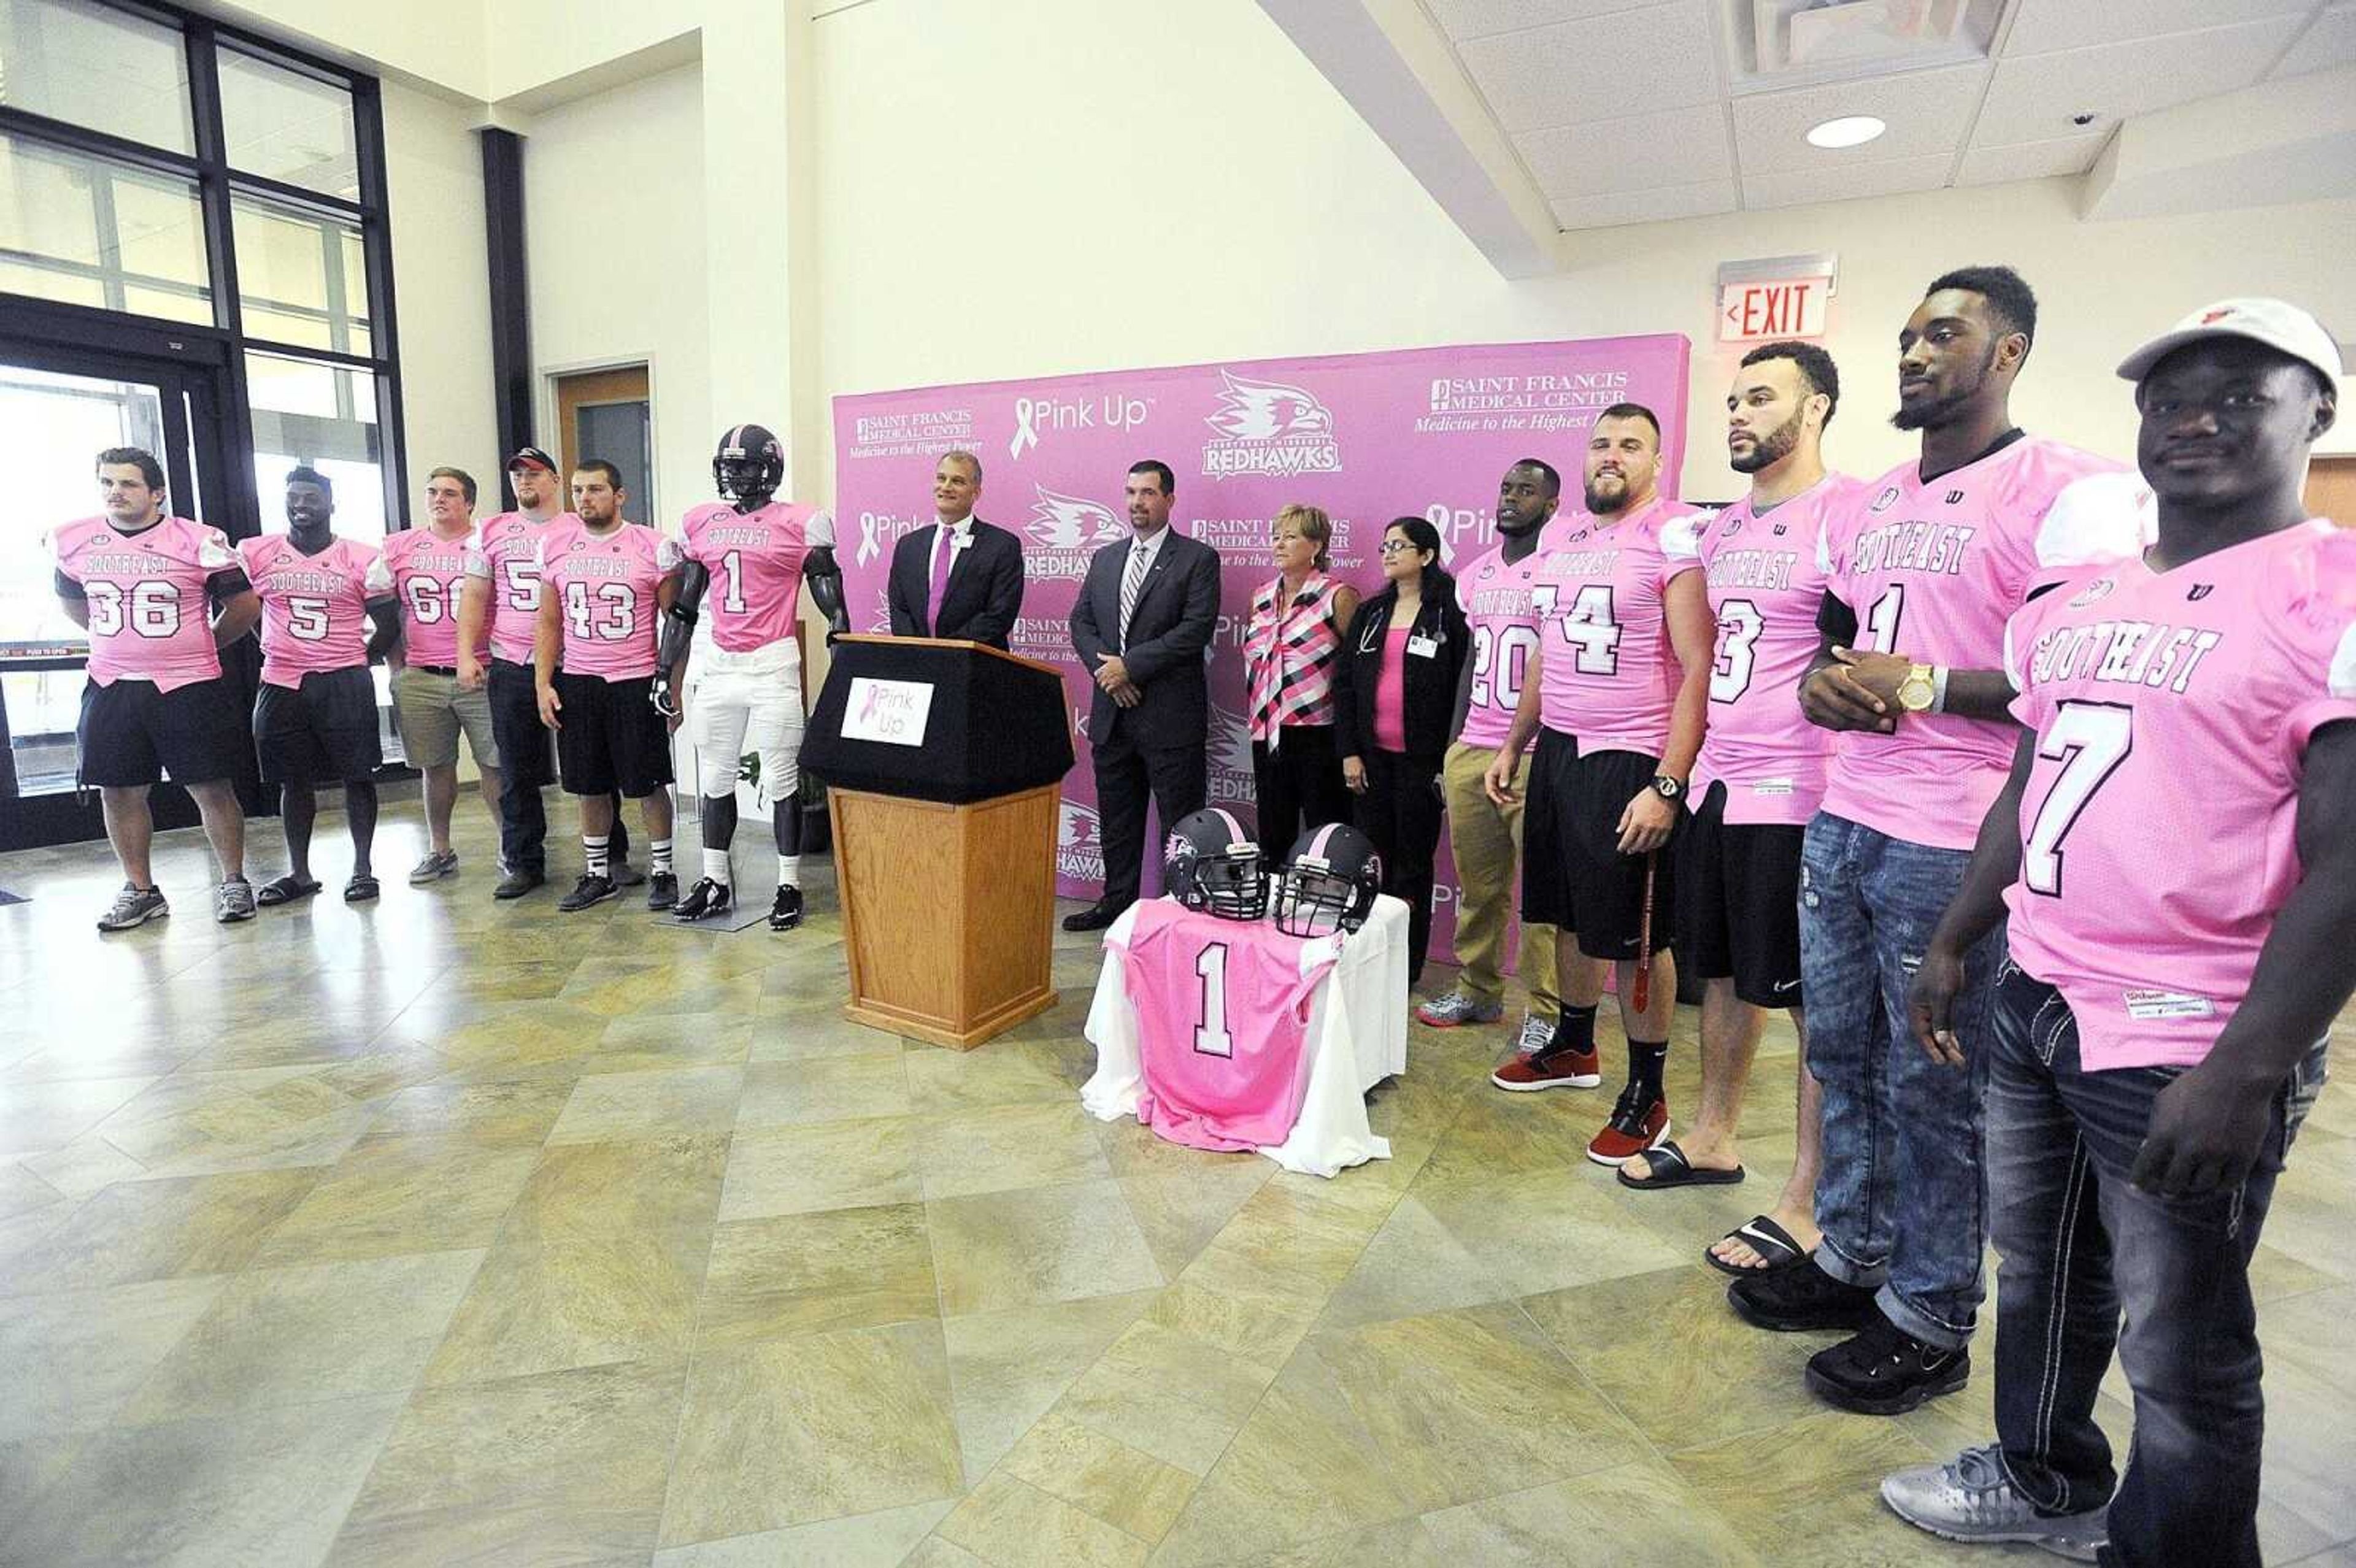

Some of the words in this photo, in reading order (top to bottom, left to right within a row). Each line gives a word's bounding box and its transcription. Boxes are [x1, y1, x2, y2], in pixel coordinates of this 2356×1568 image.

[1743, 285, 1810, 335] EXIT
[1450, 376, 1520, 393] SAINT
[1525, 371, 1628, 391] FRANCIS
[1450, 394, 1538, 410] MEDICAL
[1544, 391, 1626, 408] CENTER
[869, 414, 908, 428] SAINT
[913, 410, 971, 426] FRANCIS
[1034, 398, 1095, 431] Pink
[1104, 394, 1147, 432] Up
[1414, 416, 1479, 432] Medicine
[1484, 417, 1498, 429] to
[1502, 415, 1523, 429] the
[1530, 413, 1588, 432] Highest
[869, 428, 921, 440] MEDICAL
[922, 424, 970, 437] CENTER
[1206, 445, 1336, 472] REDHAWKS
[1207, 519, 1259, 533] SAINT
[1024, 555, 1092, 579] REDHA
[1234, 553, 1246, 567] to
[1249, 553, 1269, 567] the
[270, 572, 345, 594] SOUTHEAST
[722, 550, 746, 614] 1
[83, 580, 181, 639] 36
[287, 595, 331, 642] 5
[565, 581, 637, 641] 43
[1027, 618, 1069, 631] SAINT
[1027, 632, 1072, 645] MEDIC
[1010, 648, 1047, 661] edicine
[1049, 650, 1060, 661] to
[1061, 650, 1079, 663] the
[1709, 598, 1766, 705] 3
[2033, 620, 2223, 694] SOUTHEAST
[1471, 624, 1541, 710] 20
[878, 687, 915, 710] Pink
[879, 712, 906, 737] Up
[2024, 698, 2133, 899] 7
[1193, 941, 1233, 1059] 1
